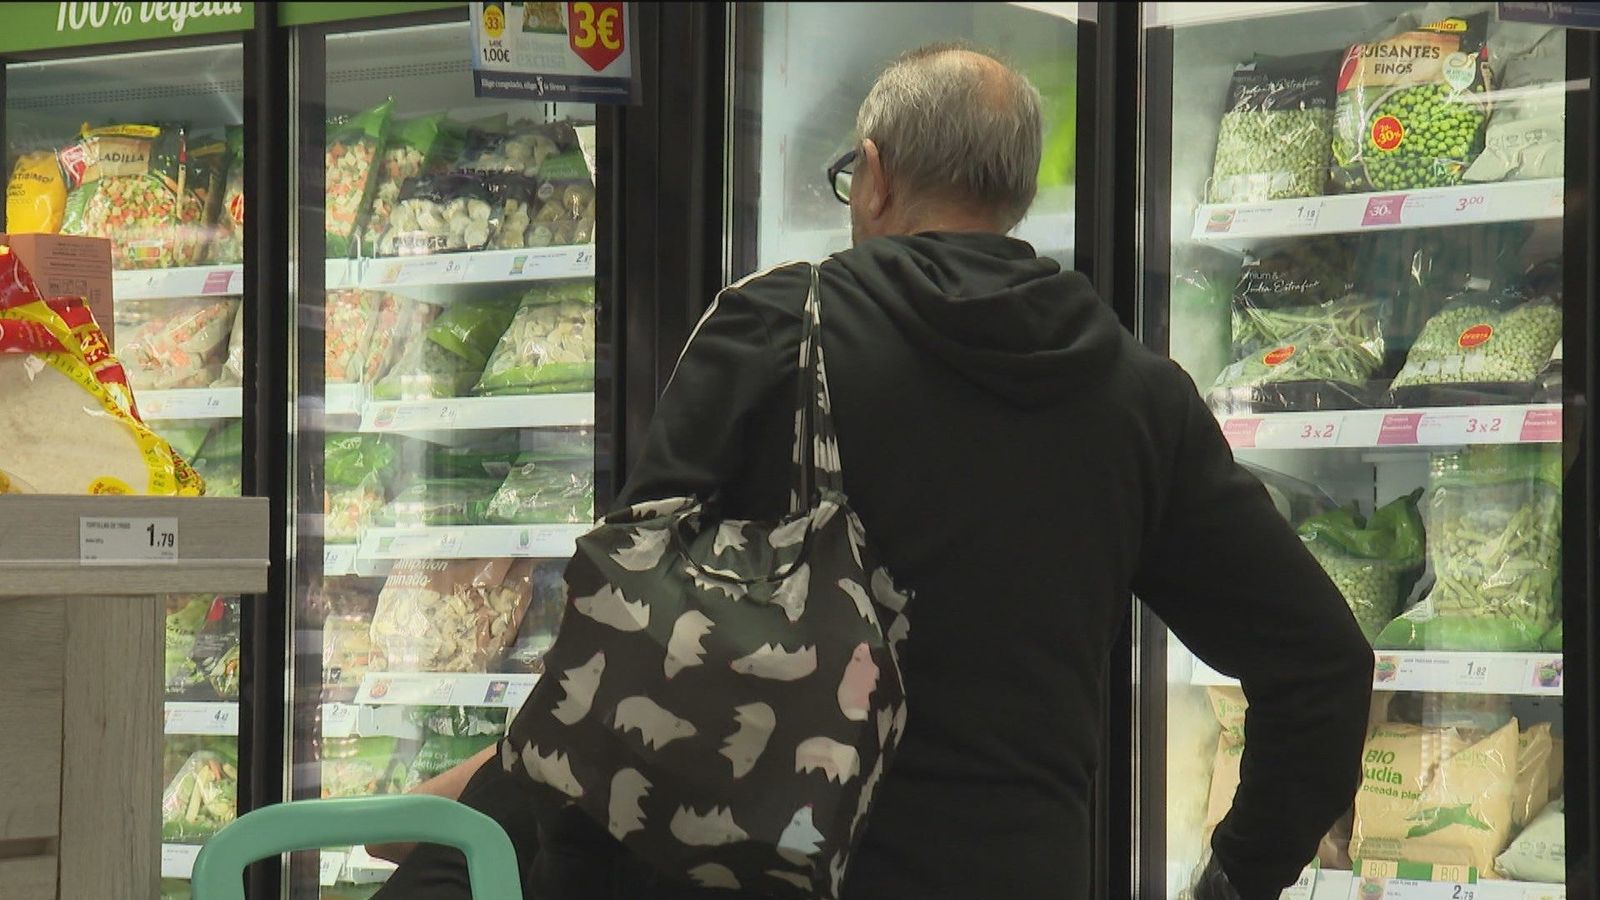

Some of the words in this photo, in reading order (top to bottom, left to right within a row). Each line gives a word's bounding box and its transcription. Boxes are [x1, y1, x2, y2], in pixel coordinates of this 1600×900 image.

[57, 2, 132, 31] 100%
[573, 3, 621, 49] 3€
[483, 48, 510, 62] 1,00€
[1361, 45, 1440, 60] UISANTES
[1374, 63, 1413, 75] FINOS
[147, 523, 175, 548] 1,79
[1365, 750, 1396, 764] BIO
